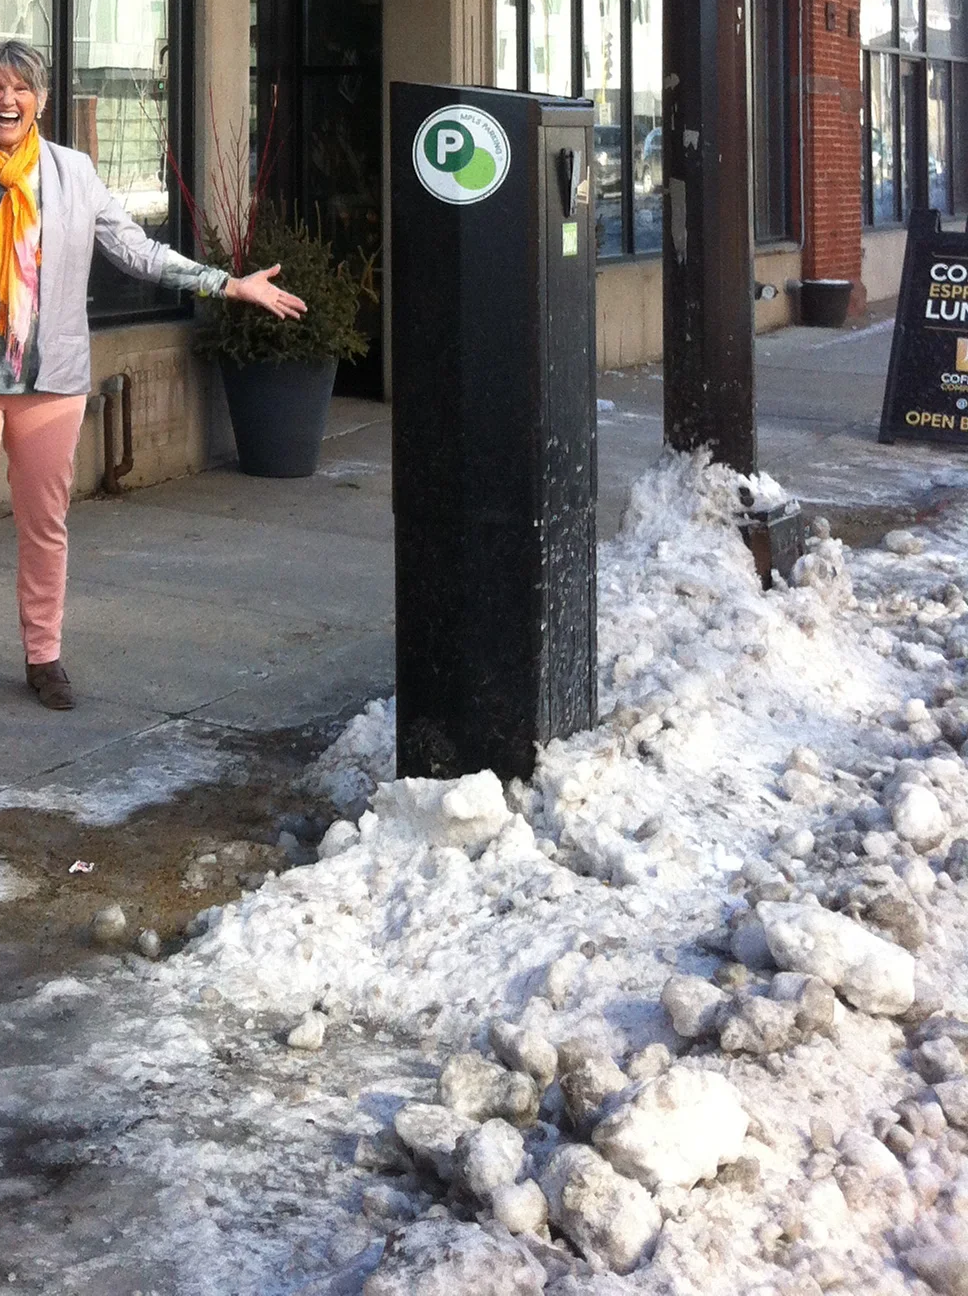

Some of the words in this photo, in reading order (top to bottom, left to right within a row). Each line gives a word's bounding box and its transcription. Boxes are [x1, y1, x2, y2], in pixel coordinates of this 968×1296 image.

[436, 128, 464, 165] P
[930, 263, 968, 282] CO
[940, 372, 968, 385] COF
[905, 410, 955, 429] OPEN
